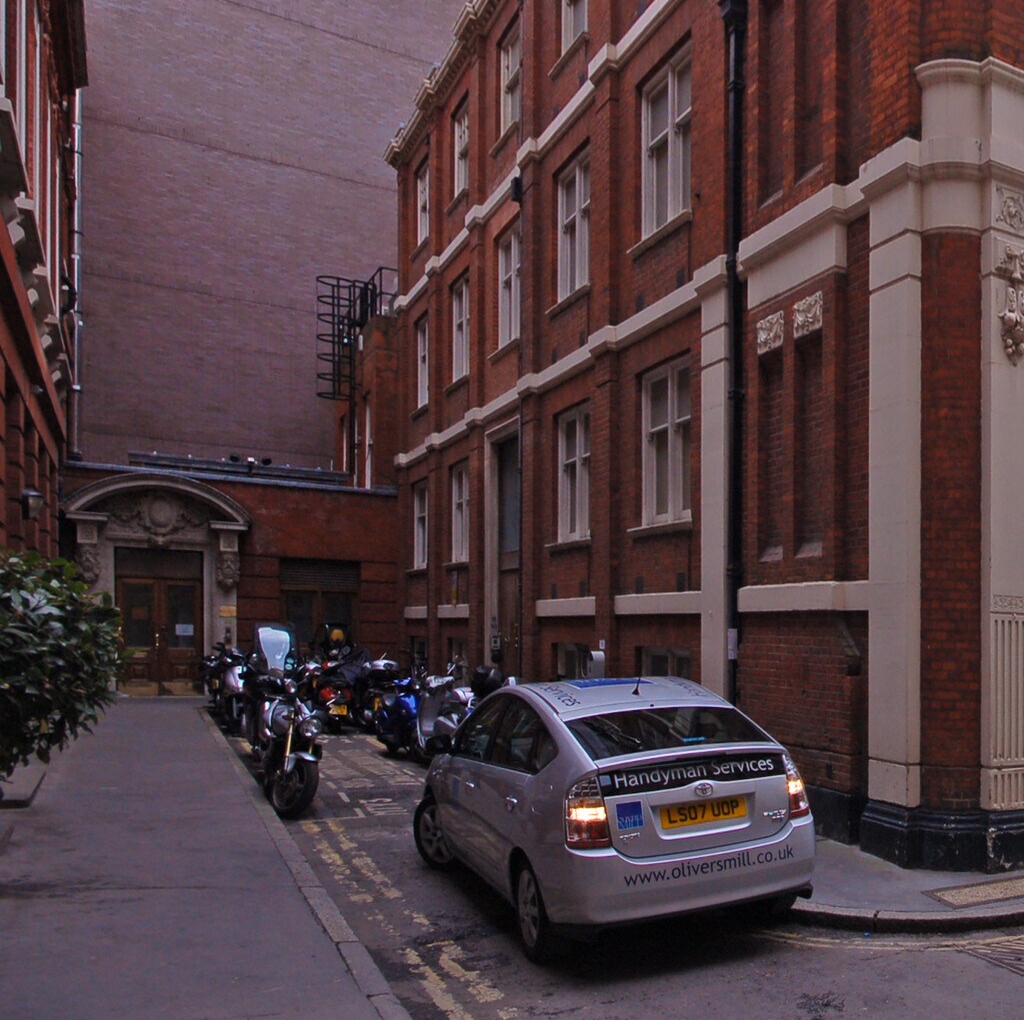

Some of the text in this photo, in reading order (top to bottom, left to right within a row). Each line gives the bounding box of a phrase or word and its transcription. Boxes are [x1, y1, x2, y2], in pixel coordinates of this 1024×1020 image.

[613, 758, 774, 789] Handyman Services
[667, 803, 707, 825] LS07
[624, 845, 794, 887] www.oliversmill.co.uk
